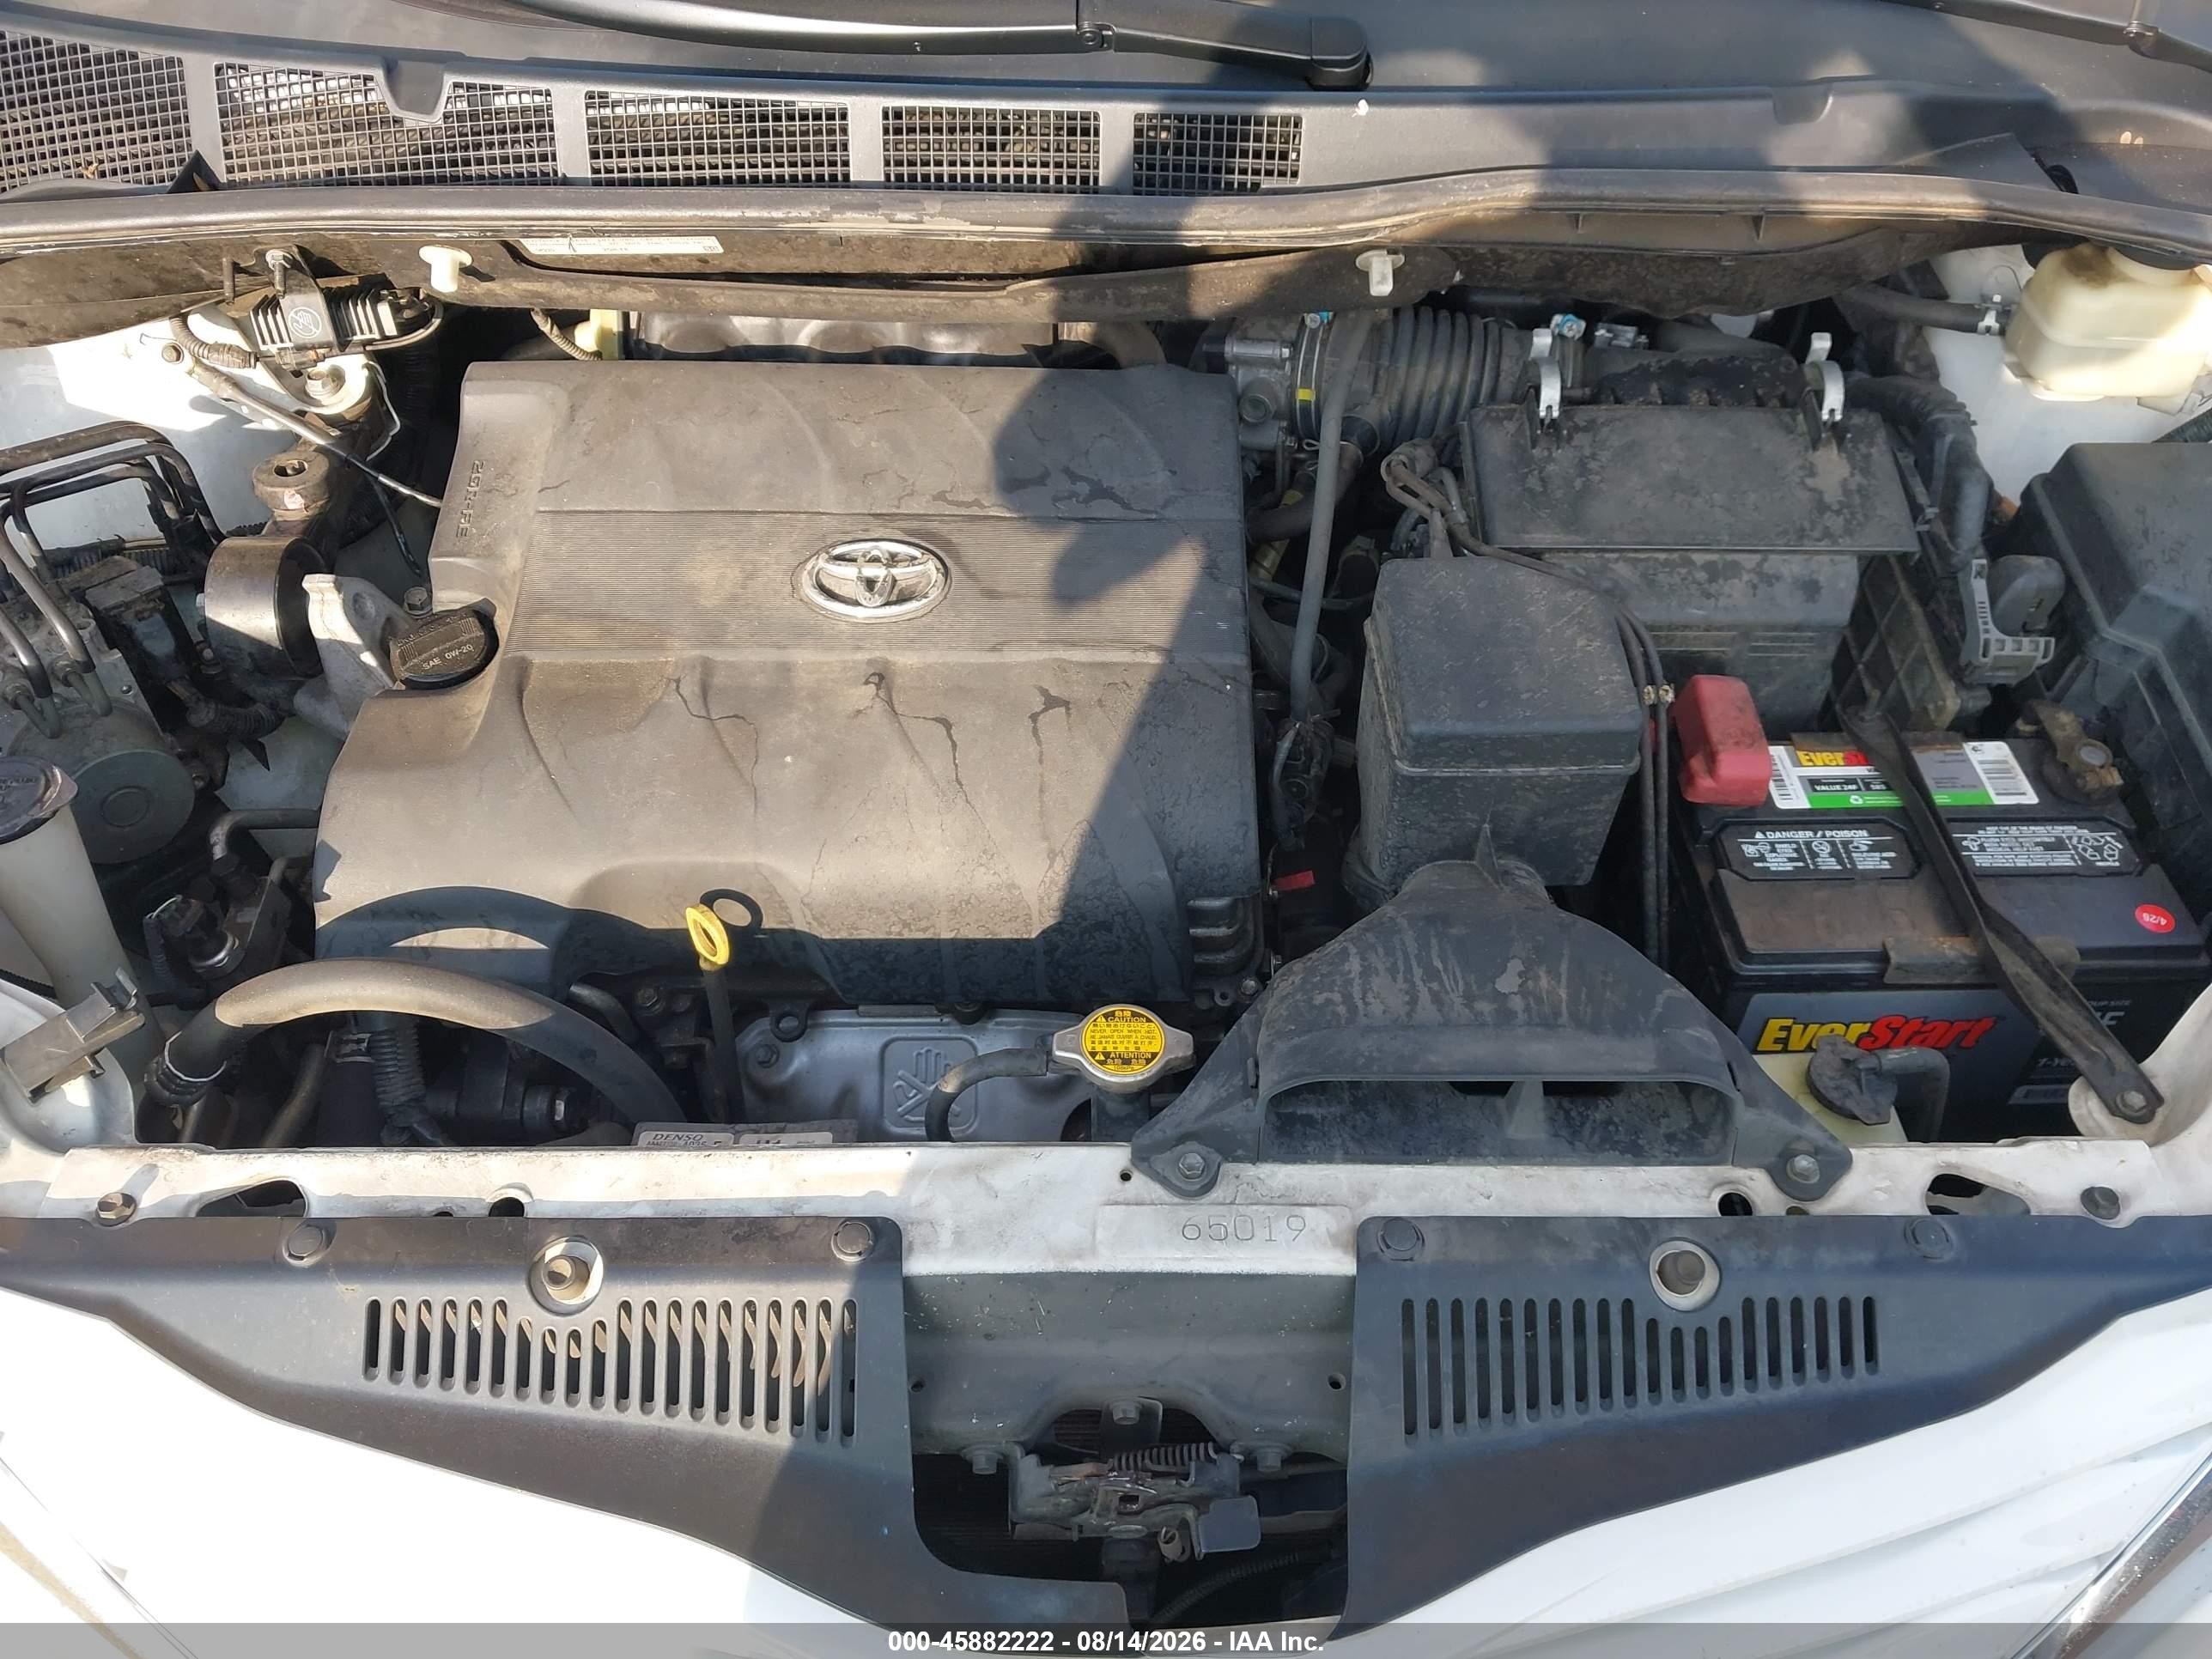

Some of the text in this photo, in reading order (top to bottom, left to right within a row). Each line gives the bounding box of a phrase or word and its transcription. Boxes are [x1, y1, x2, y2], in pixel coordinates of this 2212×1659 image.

[422, 644, 474, 670] SAE 0W-20
[1765, 830, 1814, 839] DANGER
[1824, 830, 1870, 838] POISON
[1756, 1014, 1997, 1052] EverStart
[1182, 1214, 1306, 1242] 65019
